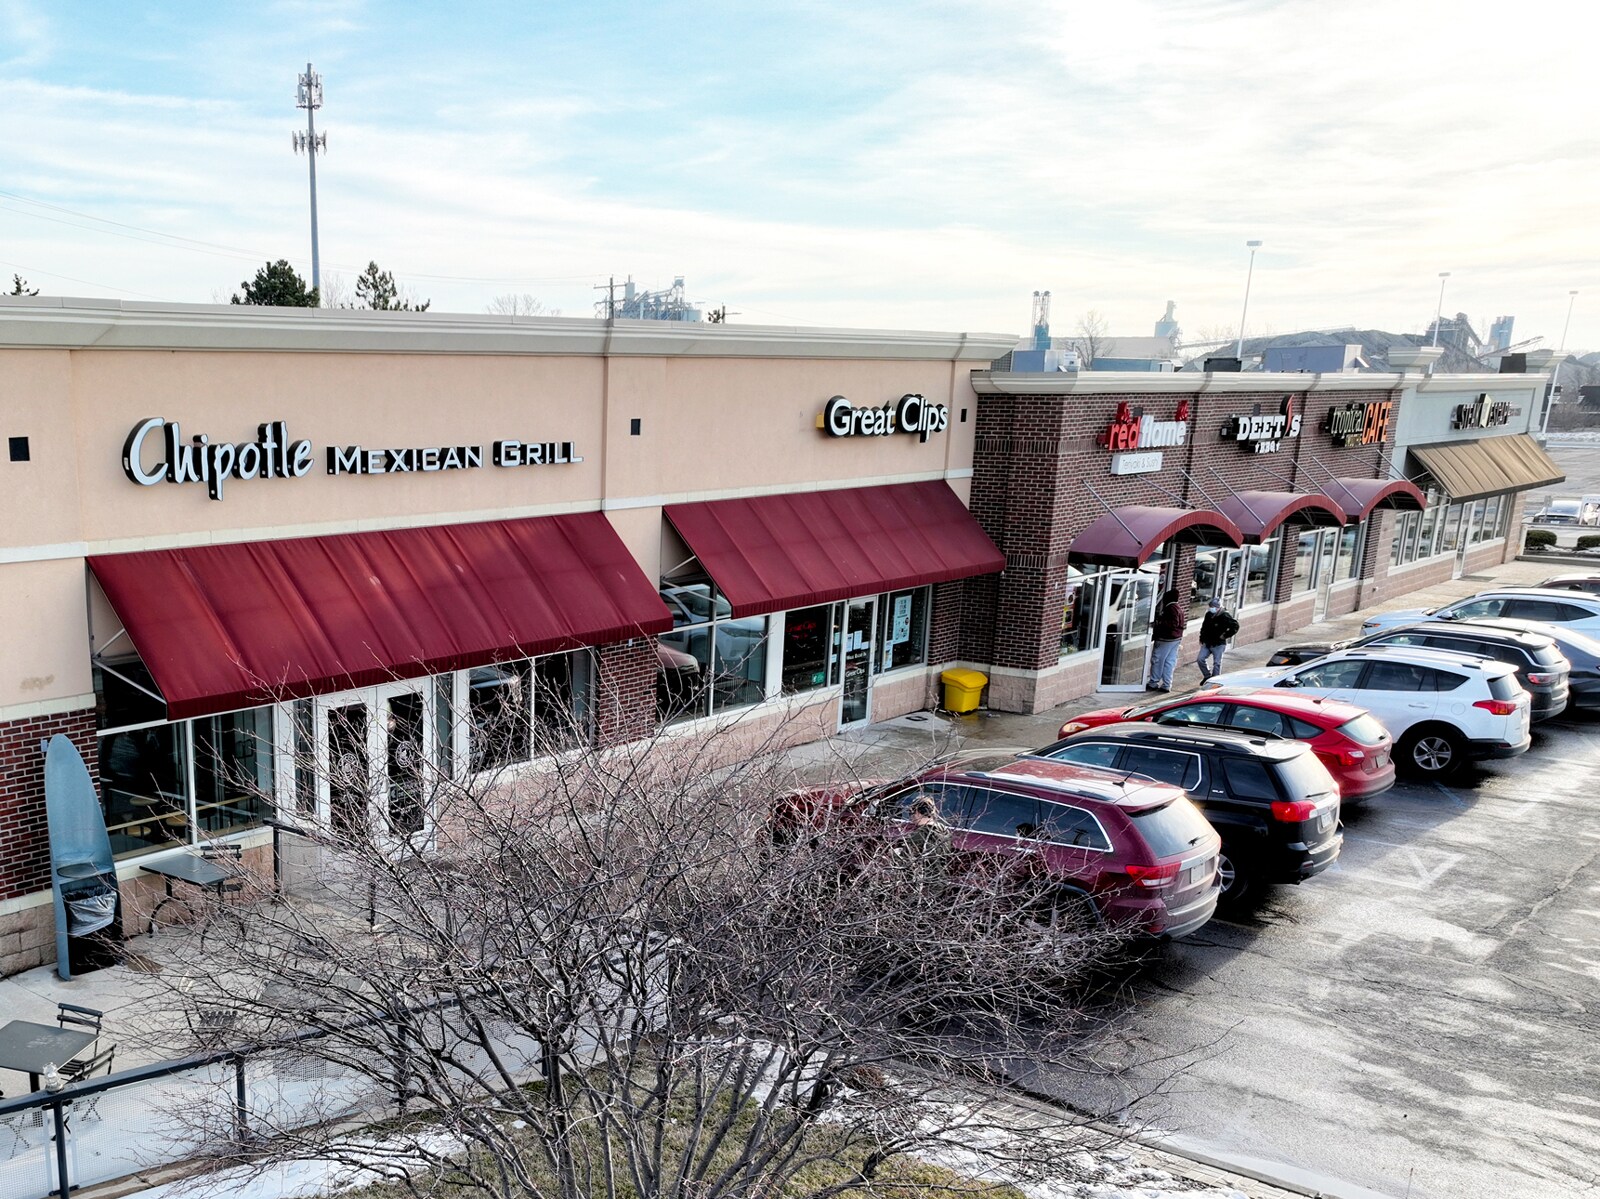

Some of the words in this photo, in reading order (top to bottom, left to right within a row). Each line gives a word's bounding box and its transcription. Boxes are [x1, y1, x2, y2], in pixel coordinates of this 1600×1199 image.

[829, 398, 896, 436] Great
[901, 394, 949, 441] Clips
[1331, 403, 1366, 439] tropical
[1362, 402, 1393, 445] CAFE
[124, 417, 315, 501] Chipotle
[331, 446, 484, 475] MEXICAN
[498, 440, 584, 467] GRILL
